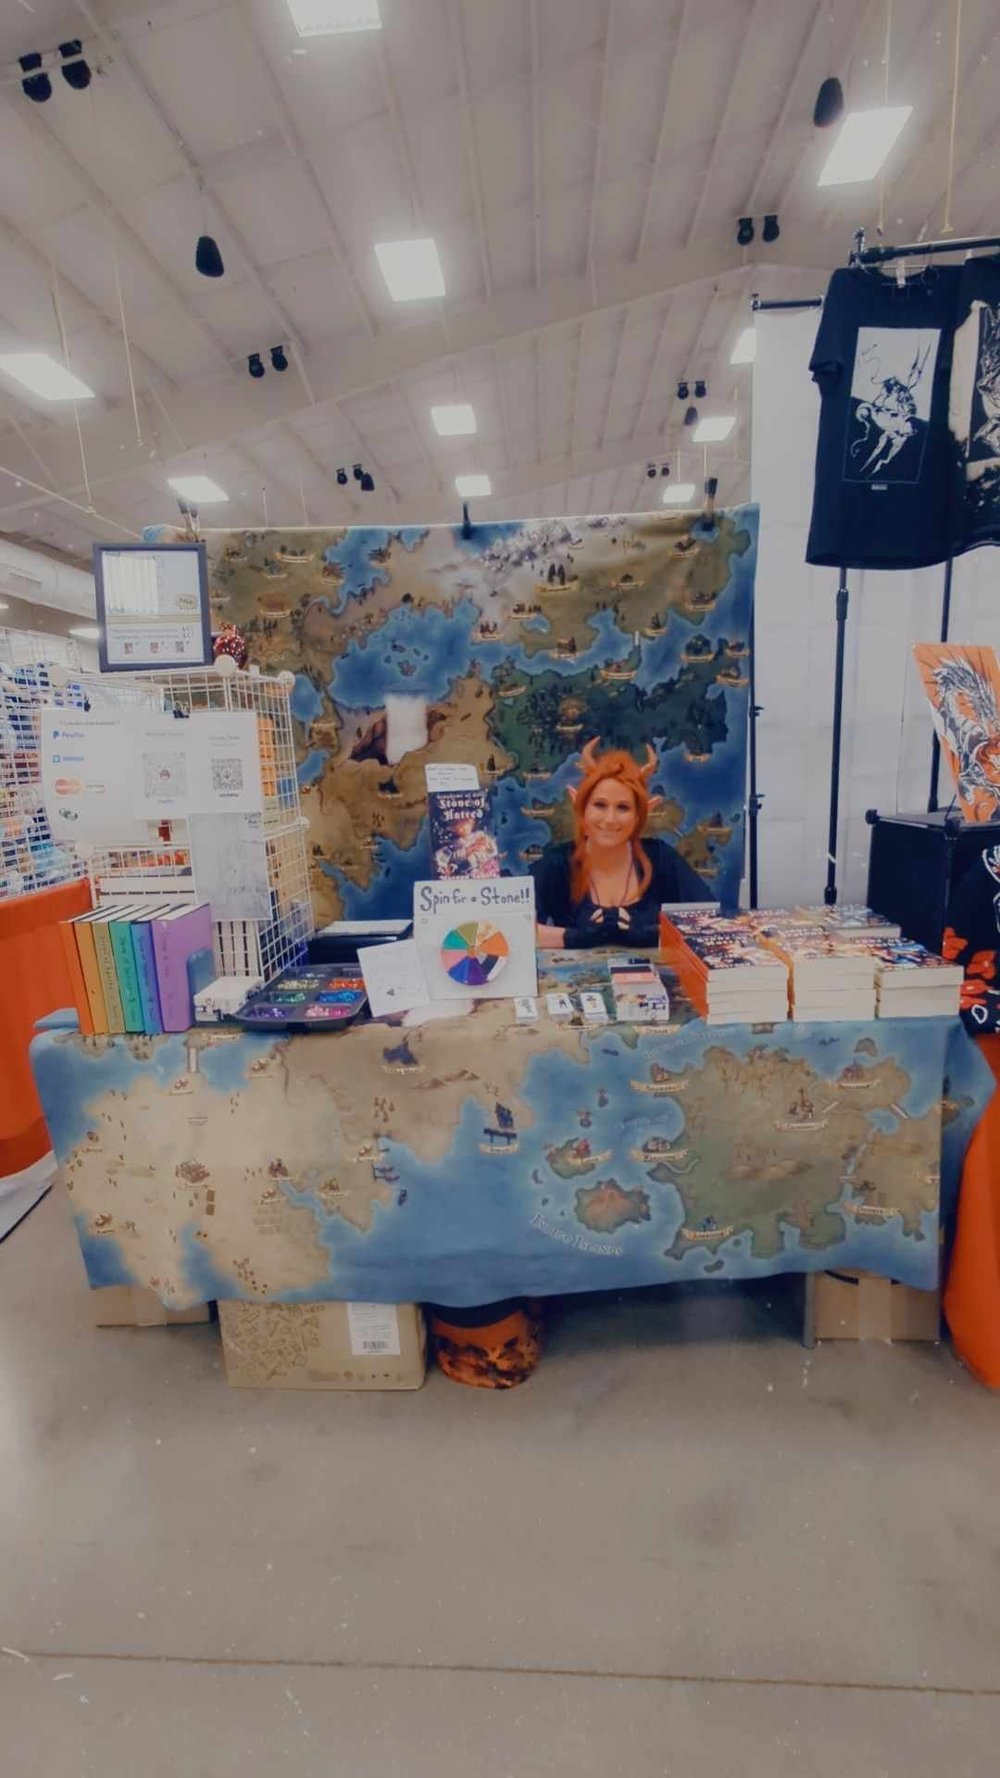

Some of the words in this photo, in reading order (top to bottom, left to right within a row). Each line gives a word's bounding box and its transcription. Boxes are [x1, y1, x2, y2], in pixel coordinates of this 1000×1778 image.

[439, 798, 471, 810] Stone
[474, 796, 485, 809] of
[443, 808, 484, 821] Hatred
[419, 885, 450, 914] Spin
[479, 885, 531, 906] Stone!!
